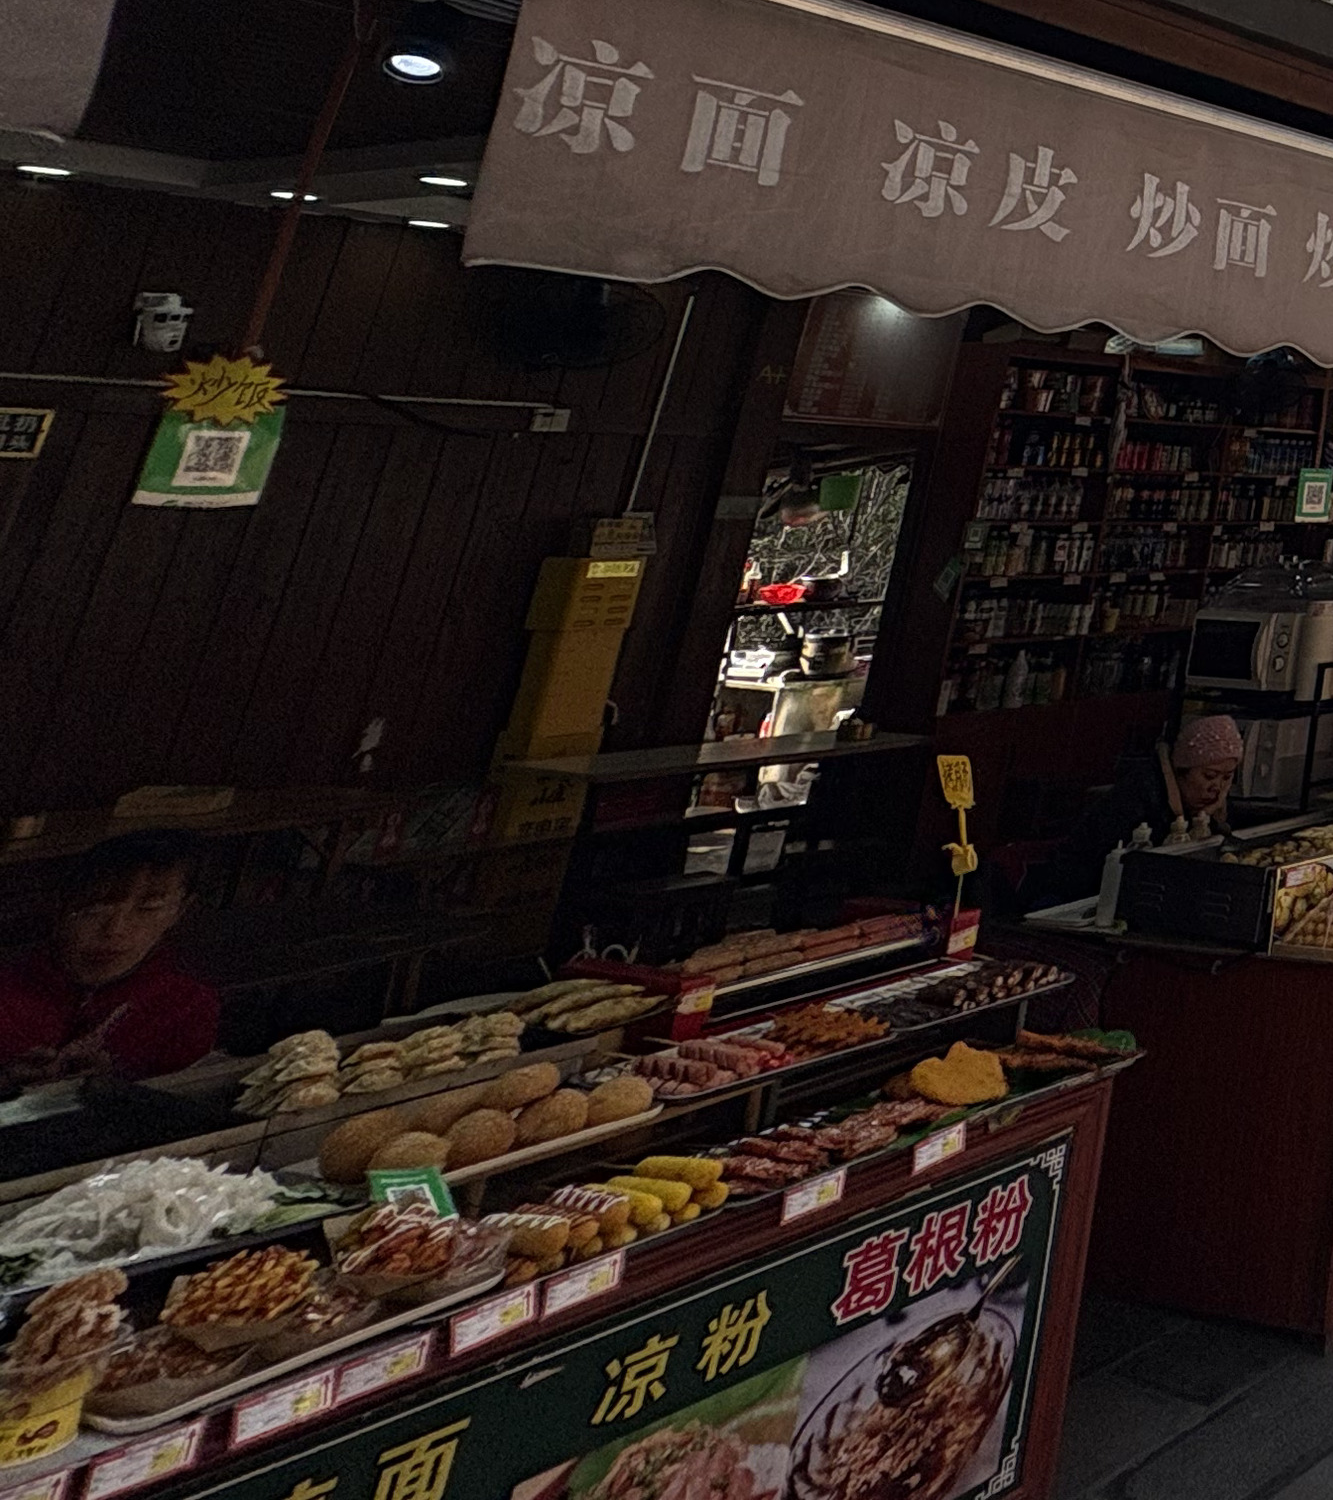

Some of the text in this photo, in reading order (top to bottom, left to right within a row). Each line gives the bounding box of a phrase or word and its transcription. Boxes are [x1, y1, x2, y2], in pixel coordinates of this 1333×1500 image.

[514, 36, 804, 186] 凉面
[881, 119, 1078, 242] 凉皮
[1127, 173, 1277, 278] 炒面
[170, 367, 273, 412] 炒饭
[278, 1174, 1032, 1500] 面 凉粉 葛根粉
